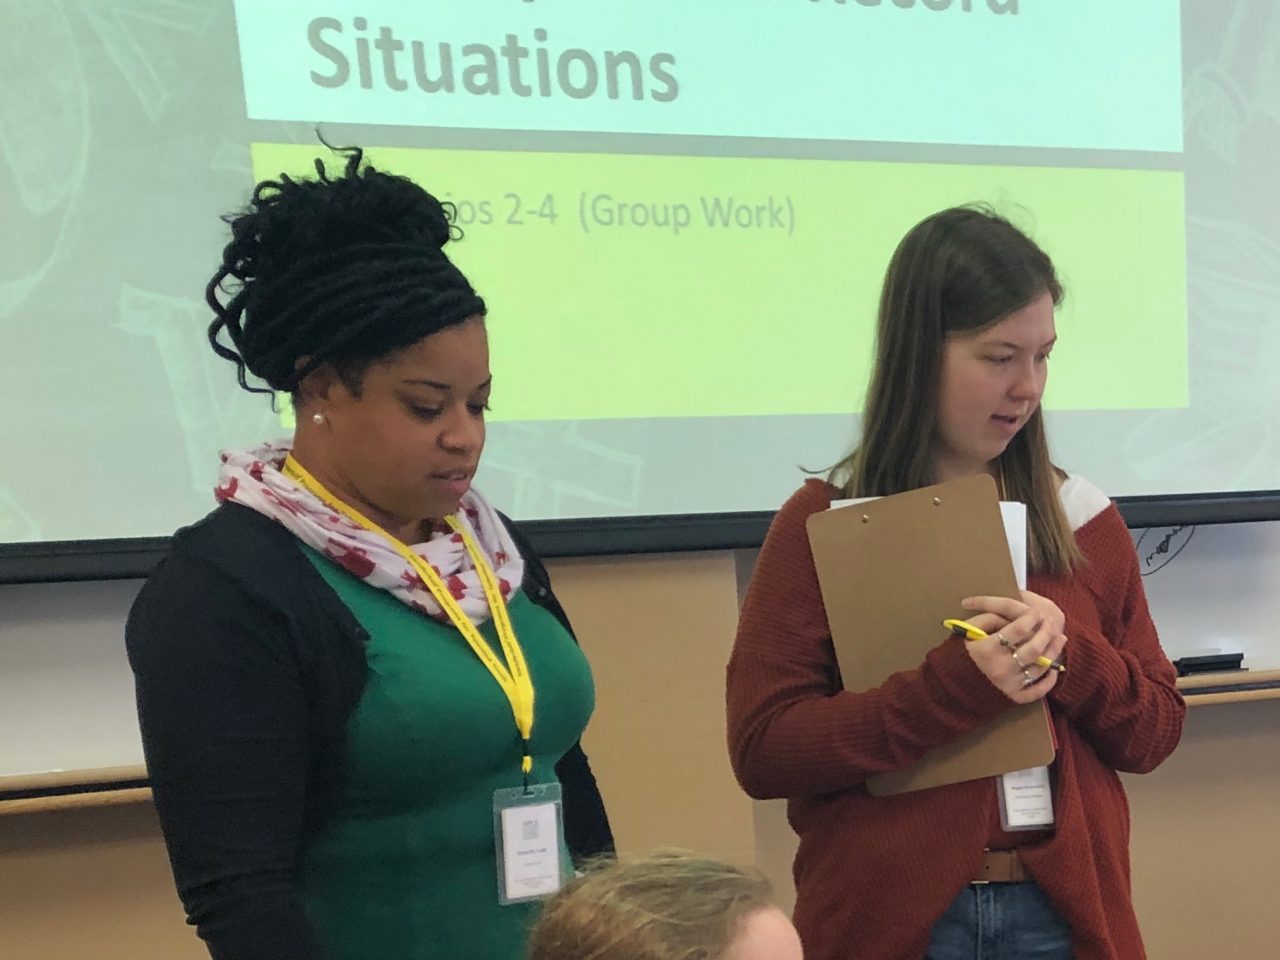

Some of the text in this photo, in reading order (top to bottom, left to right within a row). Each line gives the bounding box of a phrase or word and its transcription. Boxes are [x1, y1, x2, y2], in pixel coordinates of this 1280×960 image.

[306, 16, 680, 103] Situations
[445, 191, 796, 236] ios 2-4 (Group Work)
